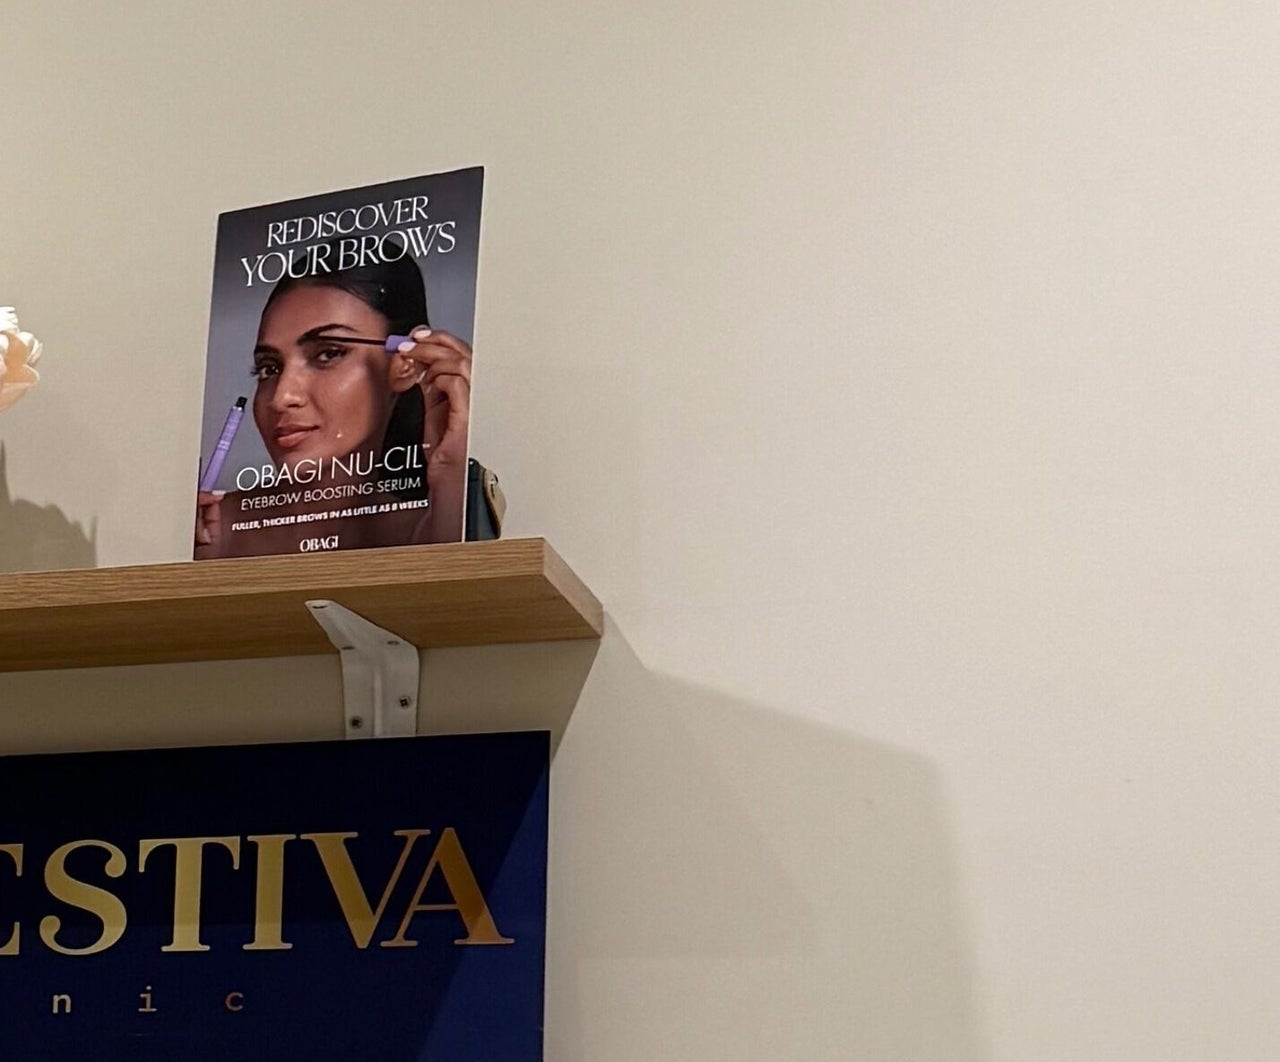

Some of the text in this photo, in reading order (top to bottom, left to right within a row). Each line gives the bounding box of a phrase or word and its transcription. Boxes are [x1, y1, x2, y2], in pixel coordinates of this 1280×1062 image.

[267, 195, 429, 248] REDISCOVER
[241, 221, 456, 287] YOUR BROWS
[236, 457, 323, 491] OBAGI
[241, 476, 422, 511] EYEBROW BOOSTING SERUM
[232, 520, 262, 531] FULLER,
[263, 515, 296, 527] THICKER
[296, 511, 328, 523] BROWS
[329, 510, 340, 519] IN
[340, 508, 353, 518] AS
[353, 506, 378, 516] LITTLE
[378, 504, 390, 513] AS
[399, 499, 429, 510] WEEKS
[299, 535, 339, 552] OBAGI
